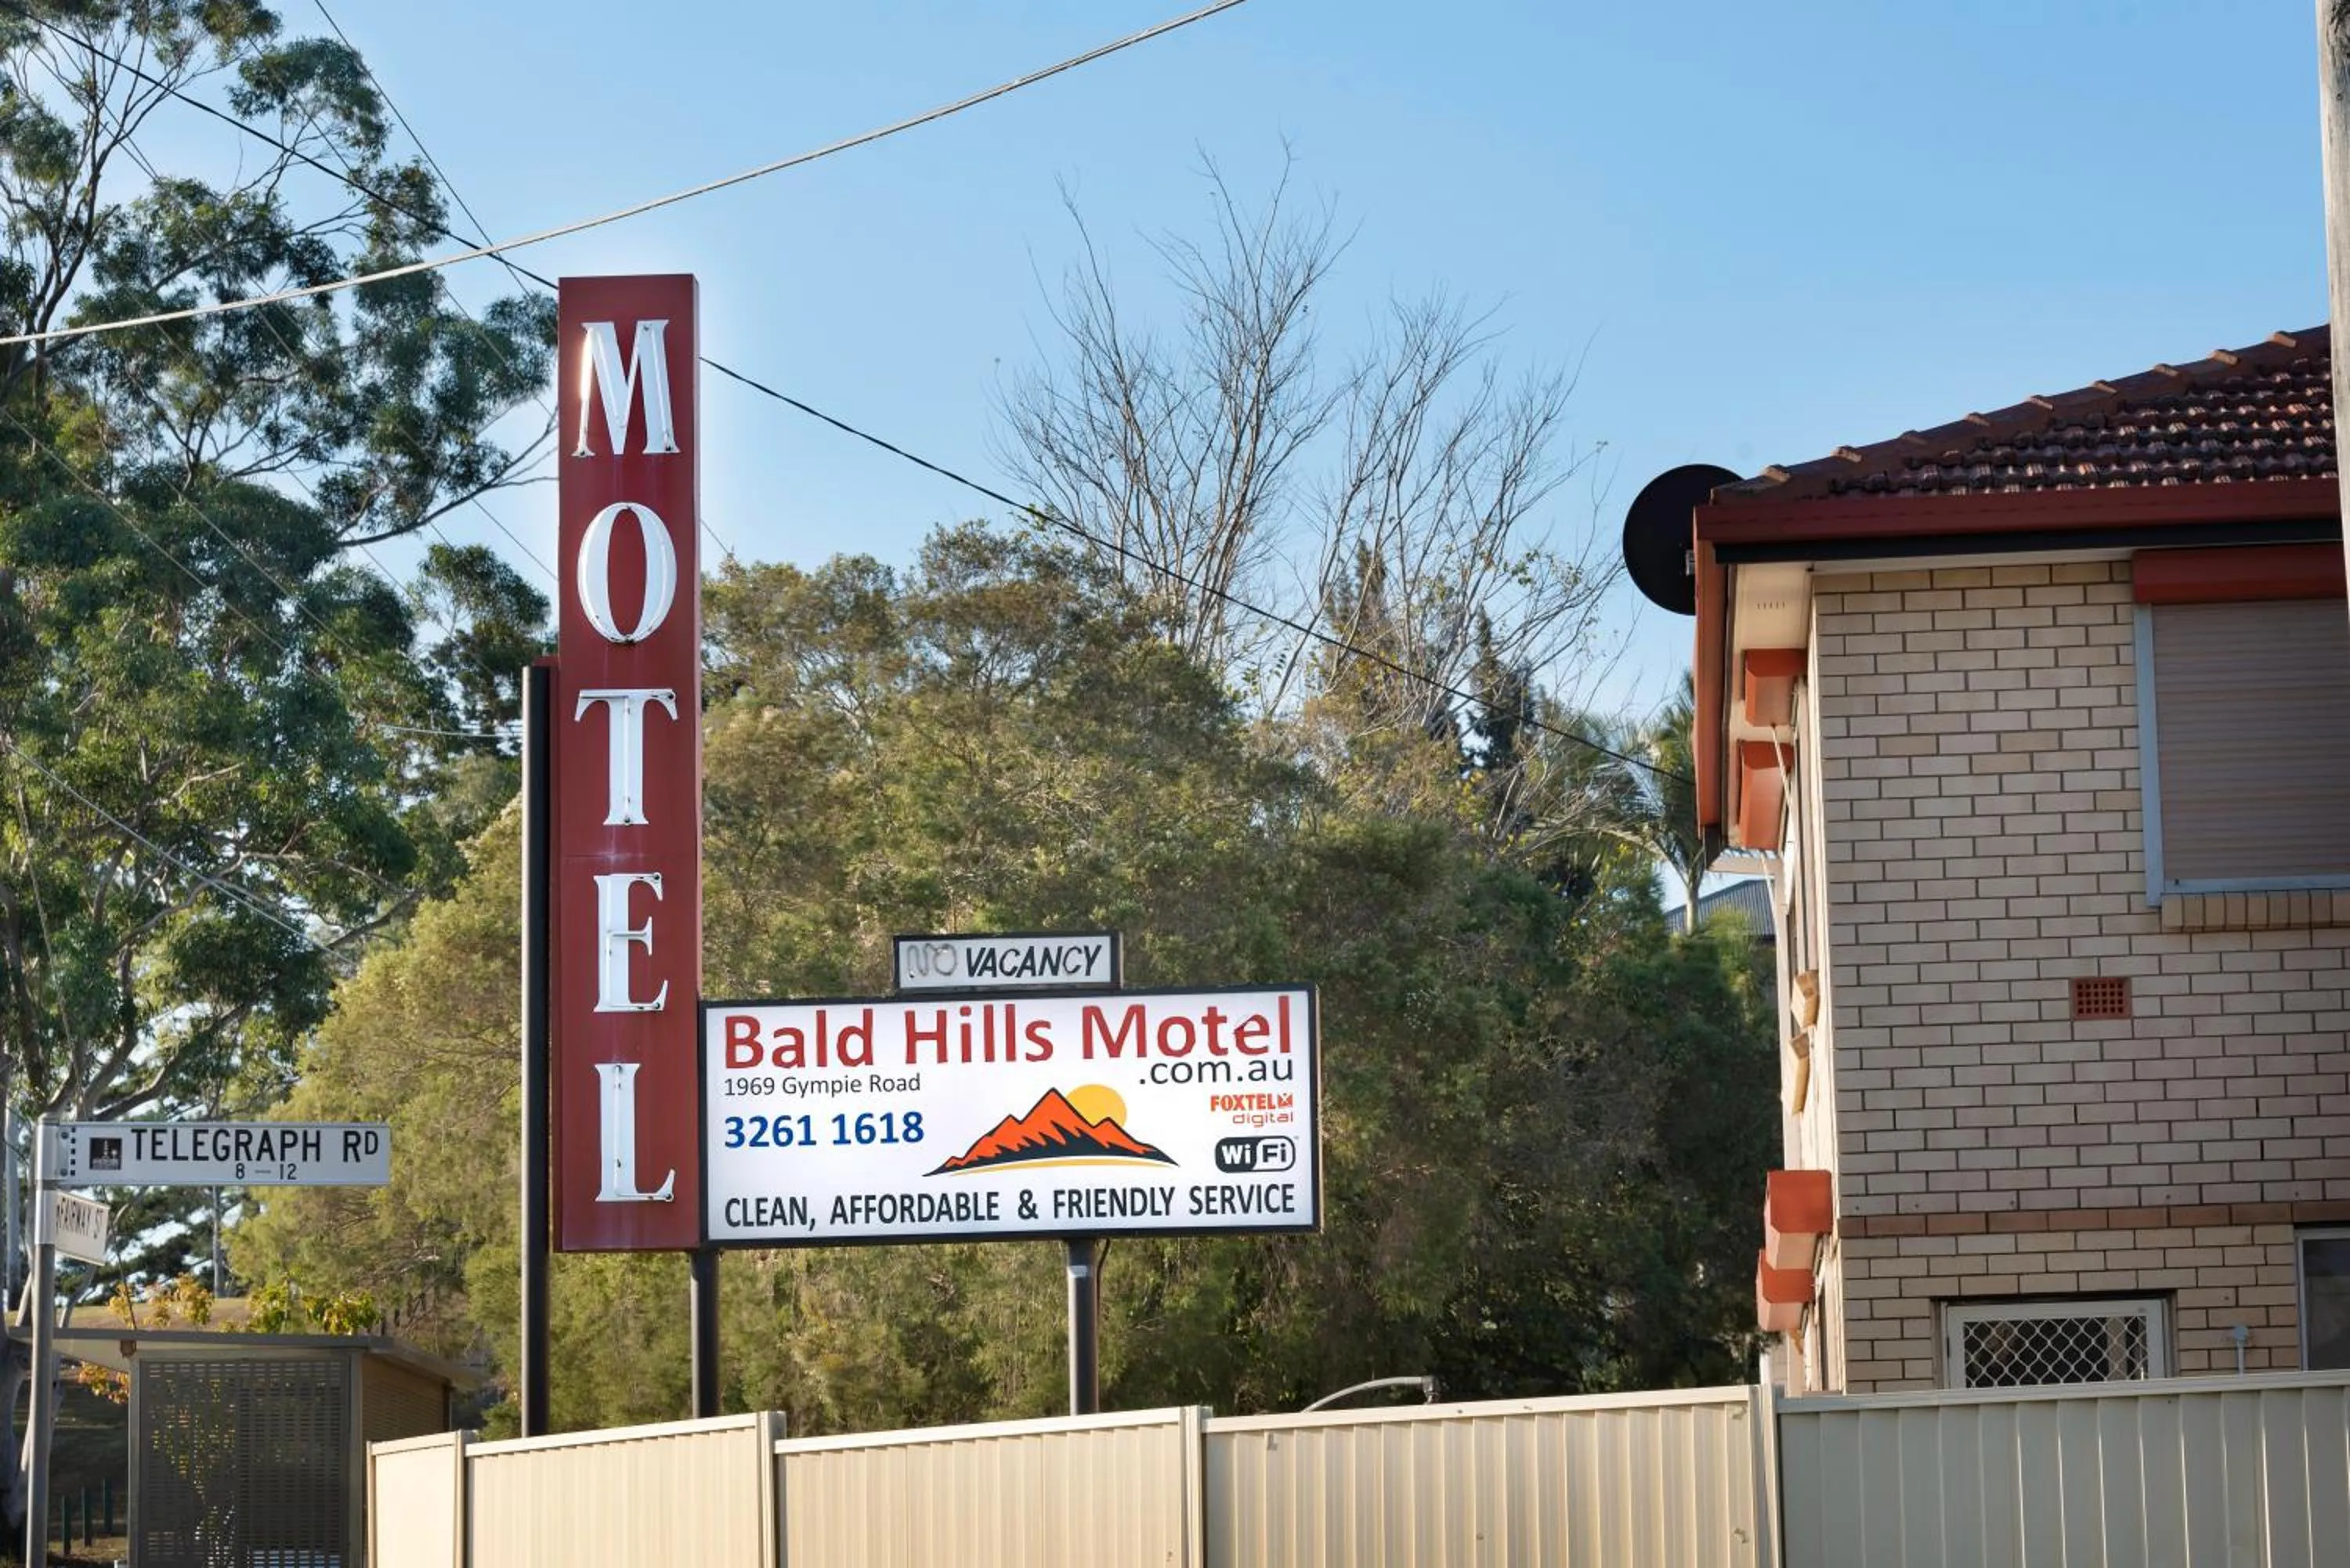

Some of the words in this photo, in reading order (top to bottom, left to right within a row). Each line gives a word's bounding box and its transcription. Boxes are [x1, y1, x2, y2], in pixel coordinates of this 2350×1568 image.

[570, 319, 681, 1202] MOTEL
[907, 943, 957, 977] NO
[966, 945, 1102, 978] VACANCY
[725, 1008, 874, 1069] Bald
[905, 1004, 1054, 1064] Hills
[1082, 995, 1291, 1060] Motel
[724, 1077, 775, 1096] 1969
[783, 1075, 862, 1098] Gympie
[870, 1072, 921, 1093] Road
[1139, 1059, 1293, 1086] .com.au
[1210, 1093, 1276, 1112] FOXTEL
[1232, 1111, 1294, 1129] digital
[131, 1128, 321, 1162] TELEGRAPH
[342, 1130, 379, 1163] RD
[725, 1115, 817, 1149] 3261
[832, 1111, 925, 1145] 1618
[236, 1162, 246, 1180] 8
[279, 1163, 297, 1180] 12
[725, 1195, 816, 1232] CLEAN,
[830, 1191, 1000, 1225] AFFORDABLE
[1018, 1189, 1039, 1220] &
[1053, 1186, 1176, 1219] FRIENDLY
[1188, 1183, 1296, 1215] SERVICE
